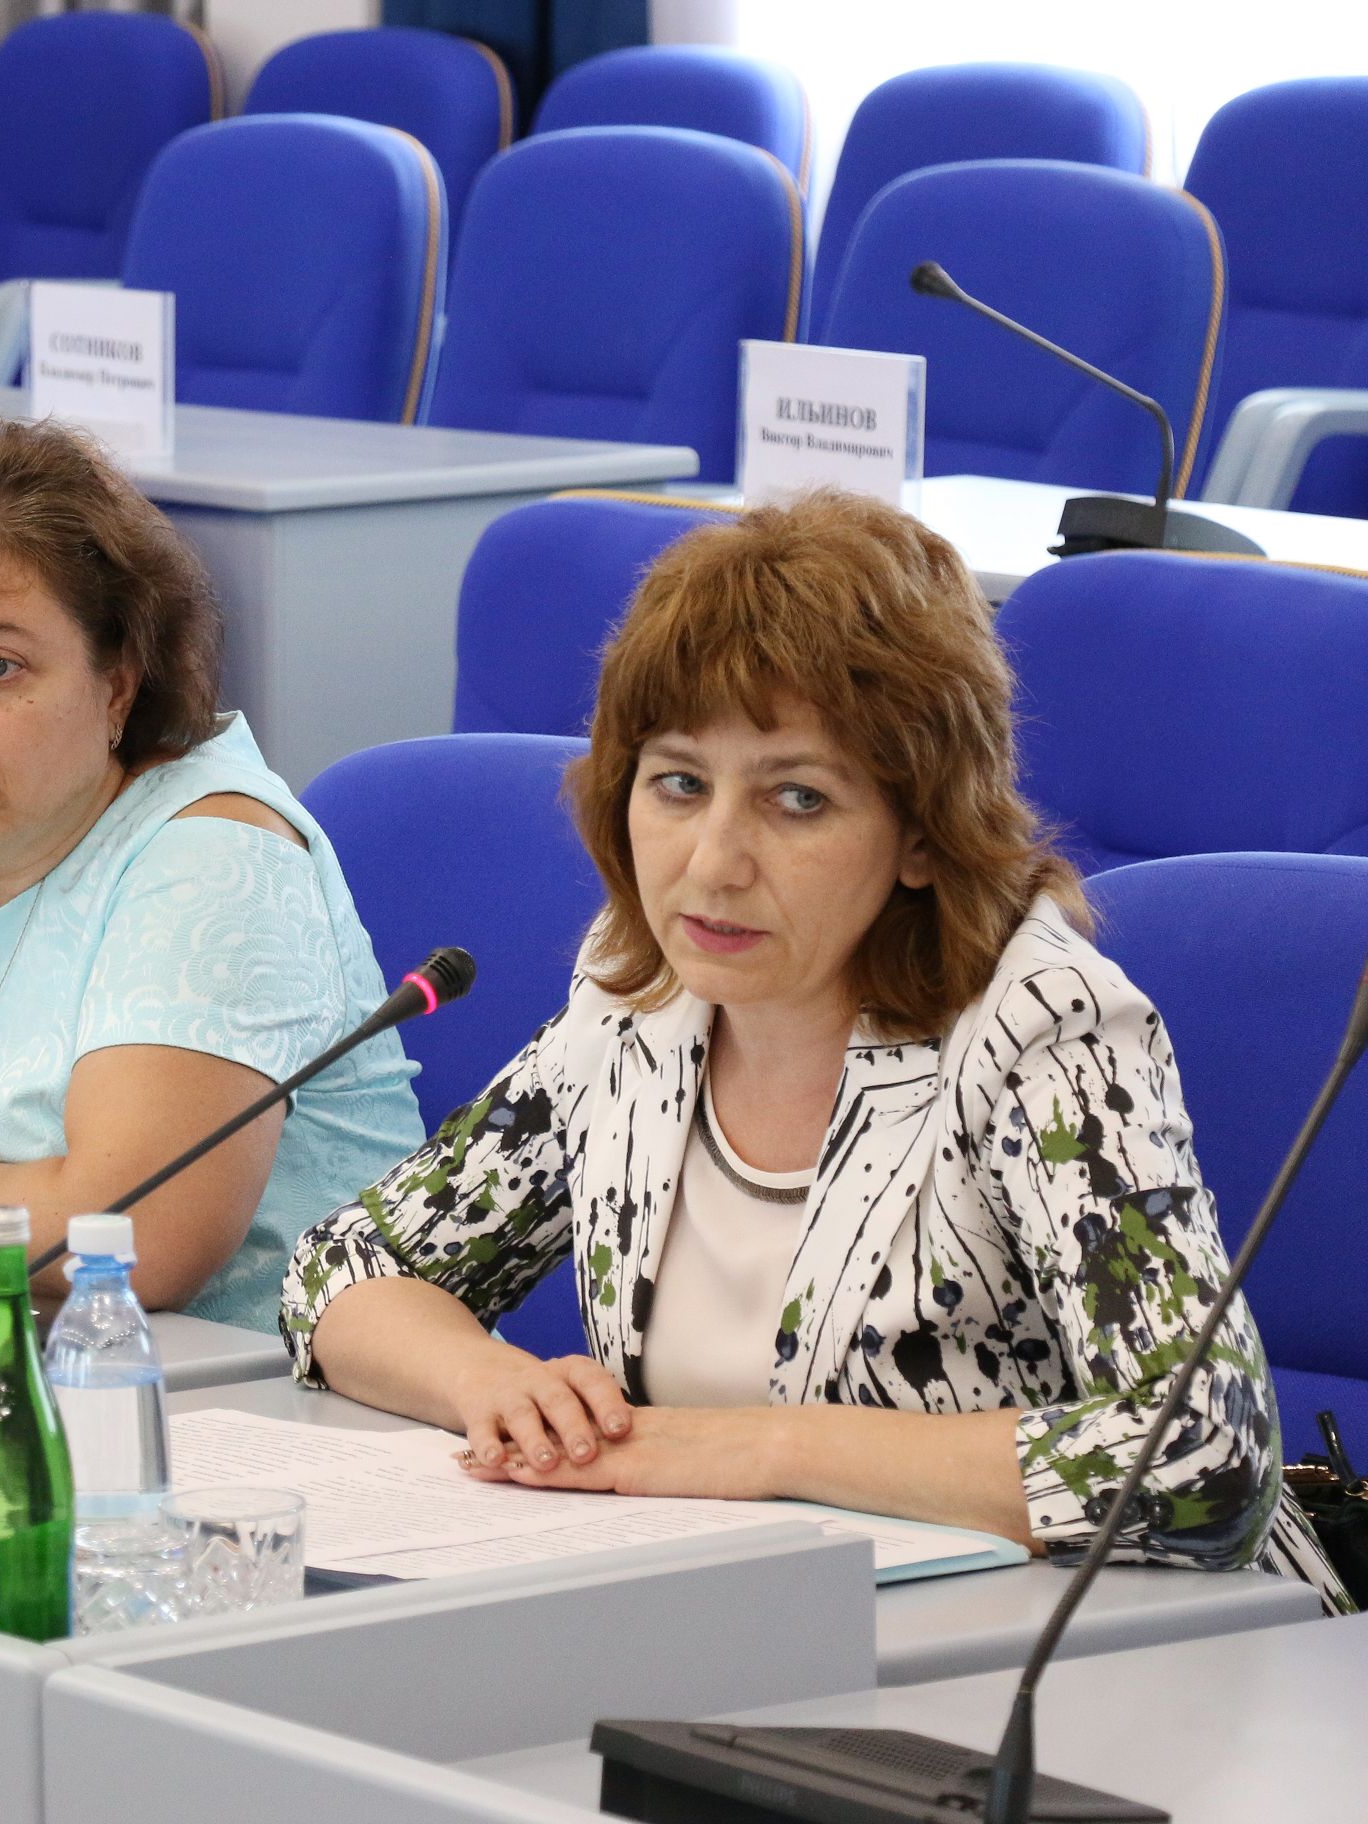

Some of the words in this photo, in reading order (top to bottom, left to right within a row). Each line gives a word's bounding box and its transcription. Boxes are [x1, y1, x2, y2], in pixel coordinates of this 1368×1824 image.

[776, 397, 878, 431] ИЛЬИНОВ
[761, 427, 803, 450] Виктор
[807, 434, 894, 459] Владимирович
